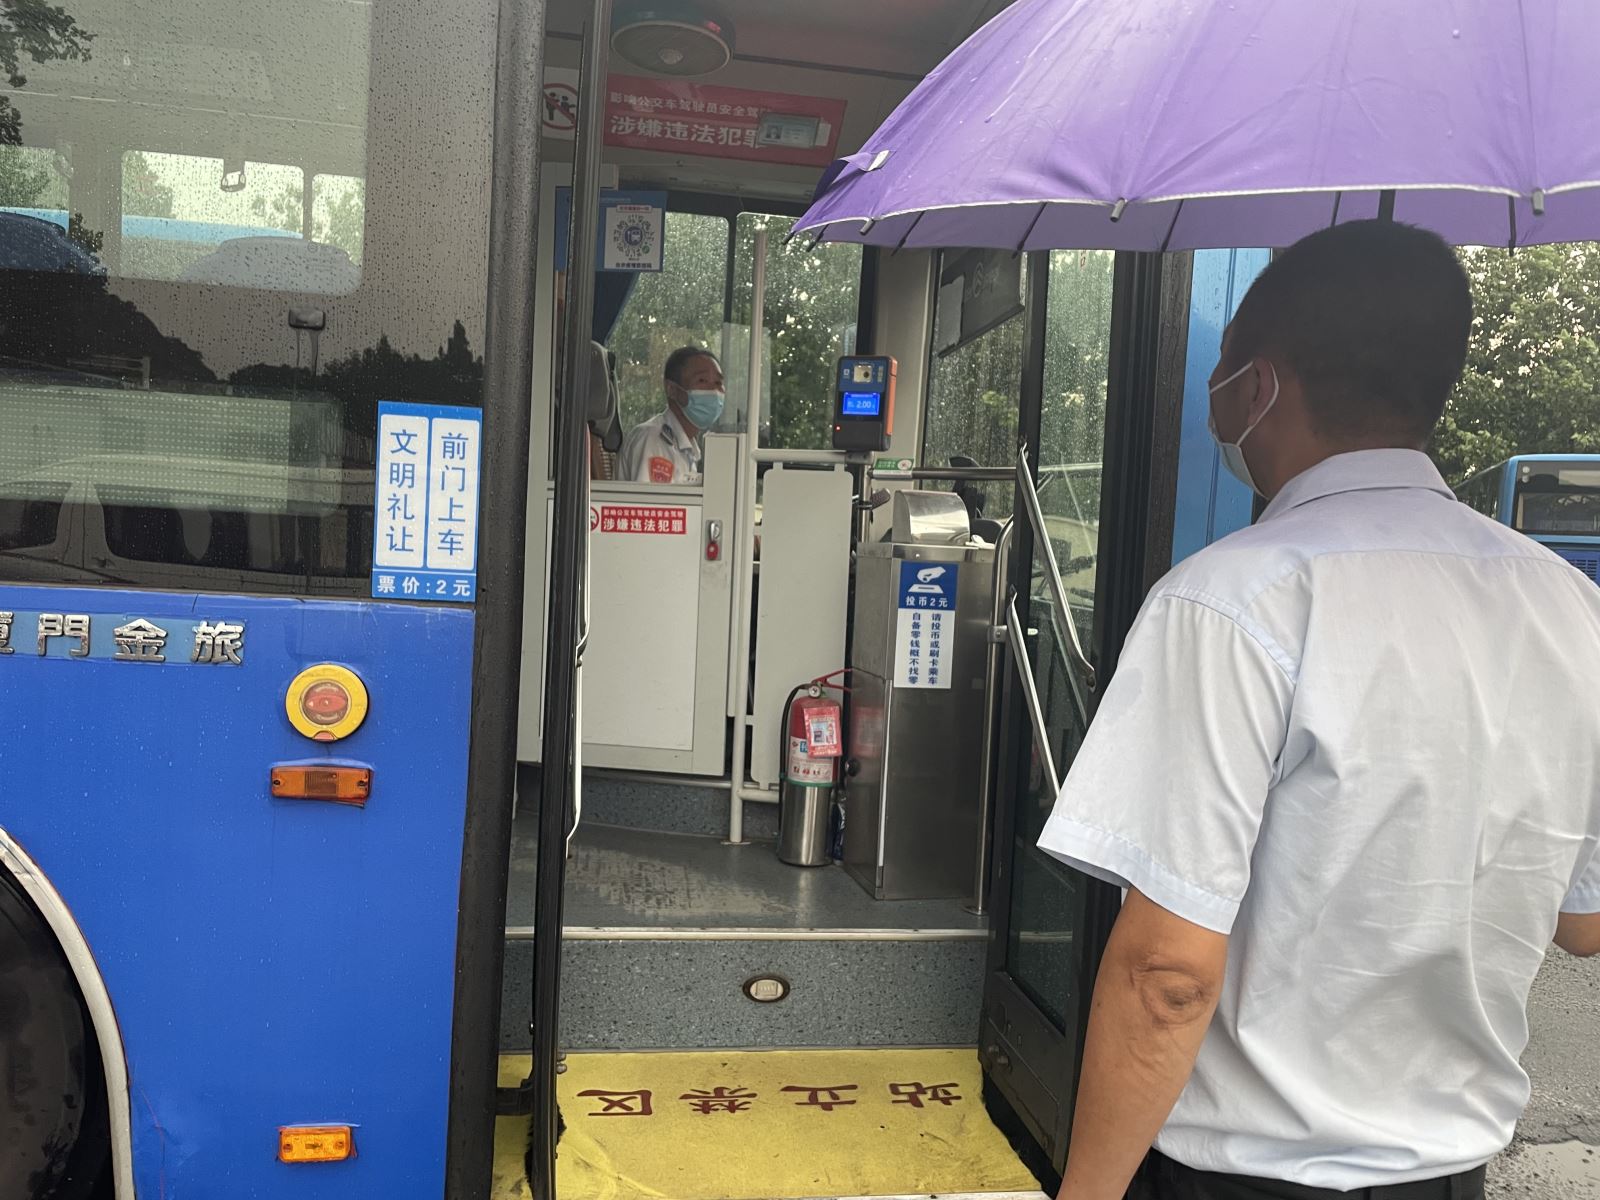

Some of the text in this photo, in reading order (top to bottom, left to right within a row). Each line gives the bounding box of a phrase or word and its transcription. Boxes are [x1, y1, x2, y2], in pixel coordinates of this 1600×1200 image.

[610, 91, 772, 118] 影响公交车驾驶员安全驾
[386, 429, 418, 553] 文明礼让
[437, 432, 469, 556] 前门上车
[603, 518, 684, 533] 涉嫌违法犯罪
[377, 575, 471, 597] 票价:2元
[905, 595, 948, 608] 投币2元
[0, 611, 245, 665] 門金旅
[908, 612, 921, 685] 自备零钱概不找零
[928, 613, 942, 685] 请投币或刷卡乘车
[576, 1082, 963, 1117] 站立禁区
